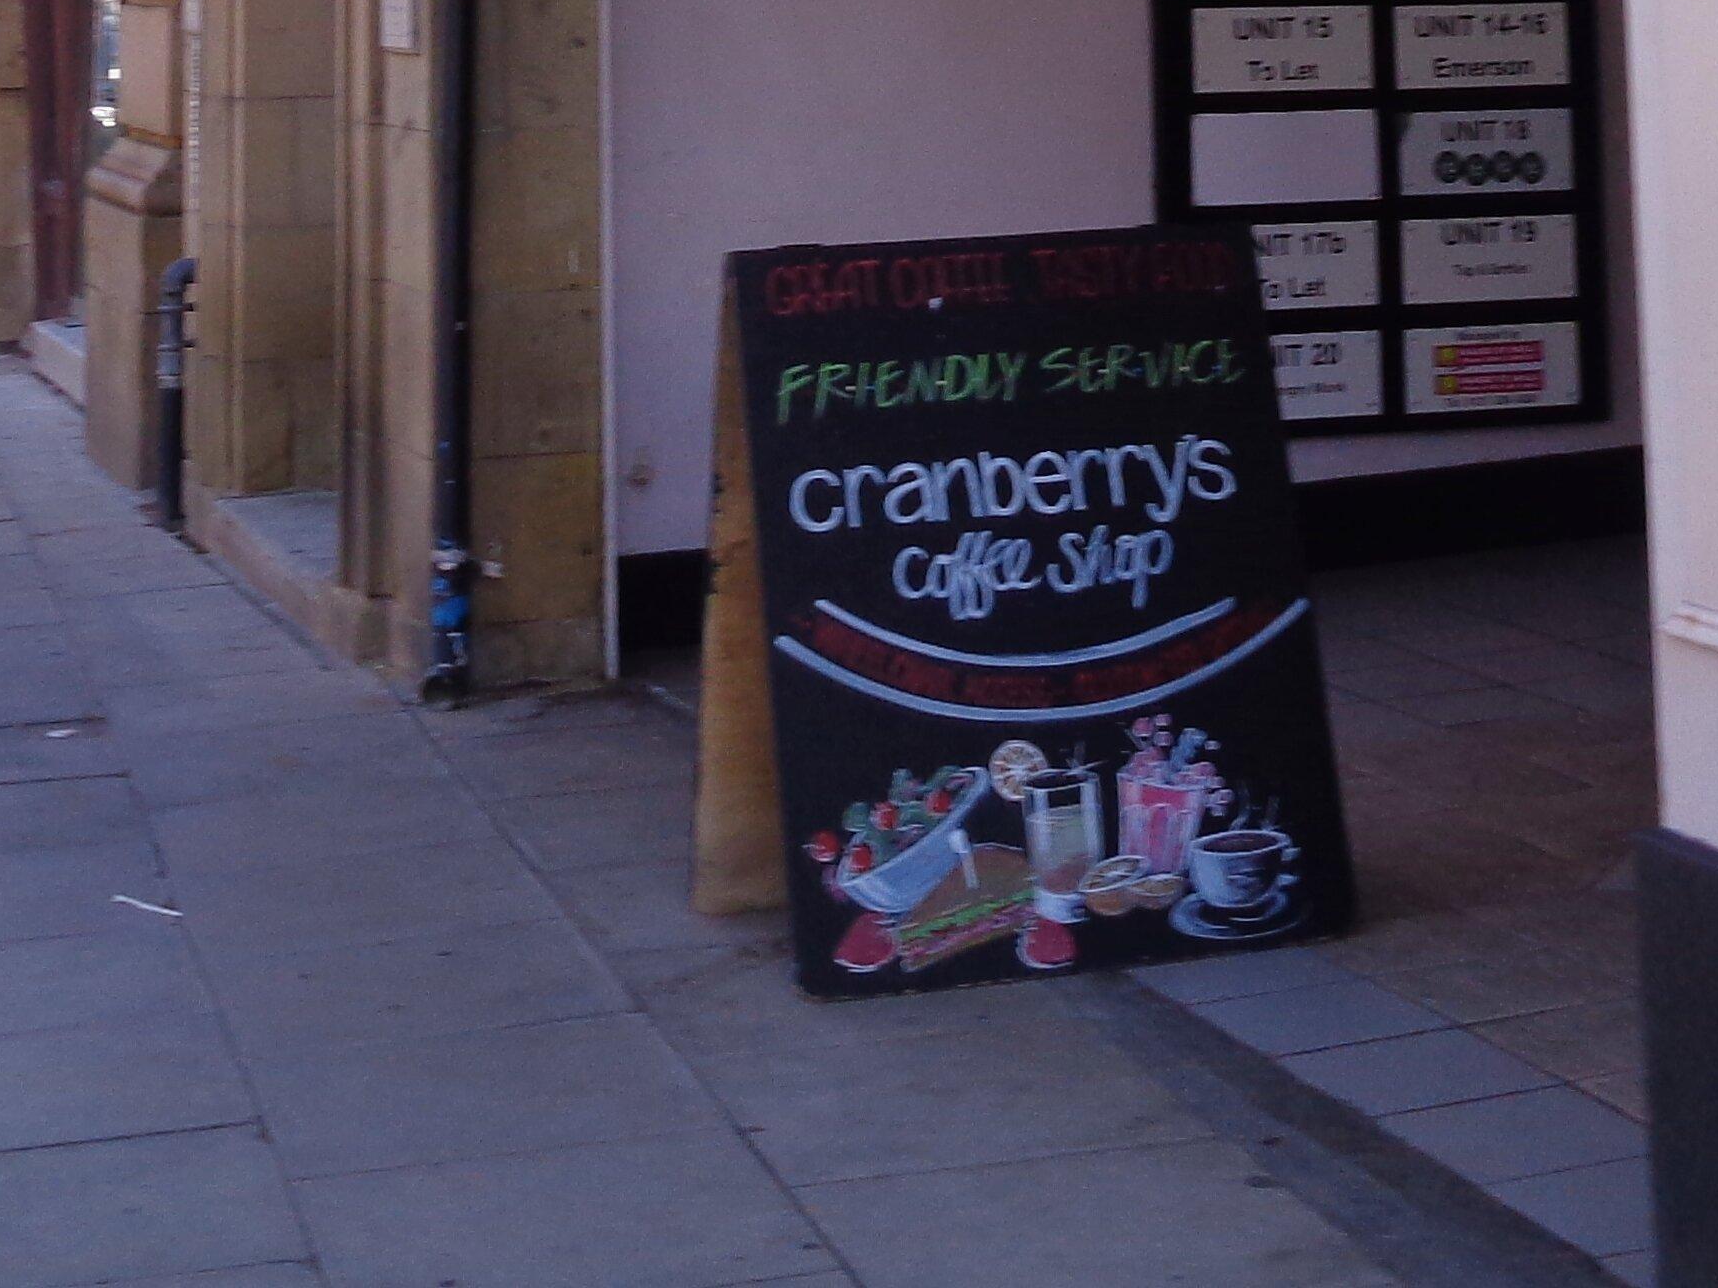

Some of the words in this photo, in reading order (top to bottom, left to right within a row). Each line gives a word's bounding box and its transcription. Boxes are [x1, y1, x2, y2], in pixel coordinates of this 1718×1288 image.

[1232, 17, 1296, 40] UNIT
[1414, 14, 1475, 37] UNIT
[776, 352, 1026, 423] FRIENDLY
[1039, 338, 1246, 394] SERVICE
[1046, 524, 1174, 609] Shop
